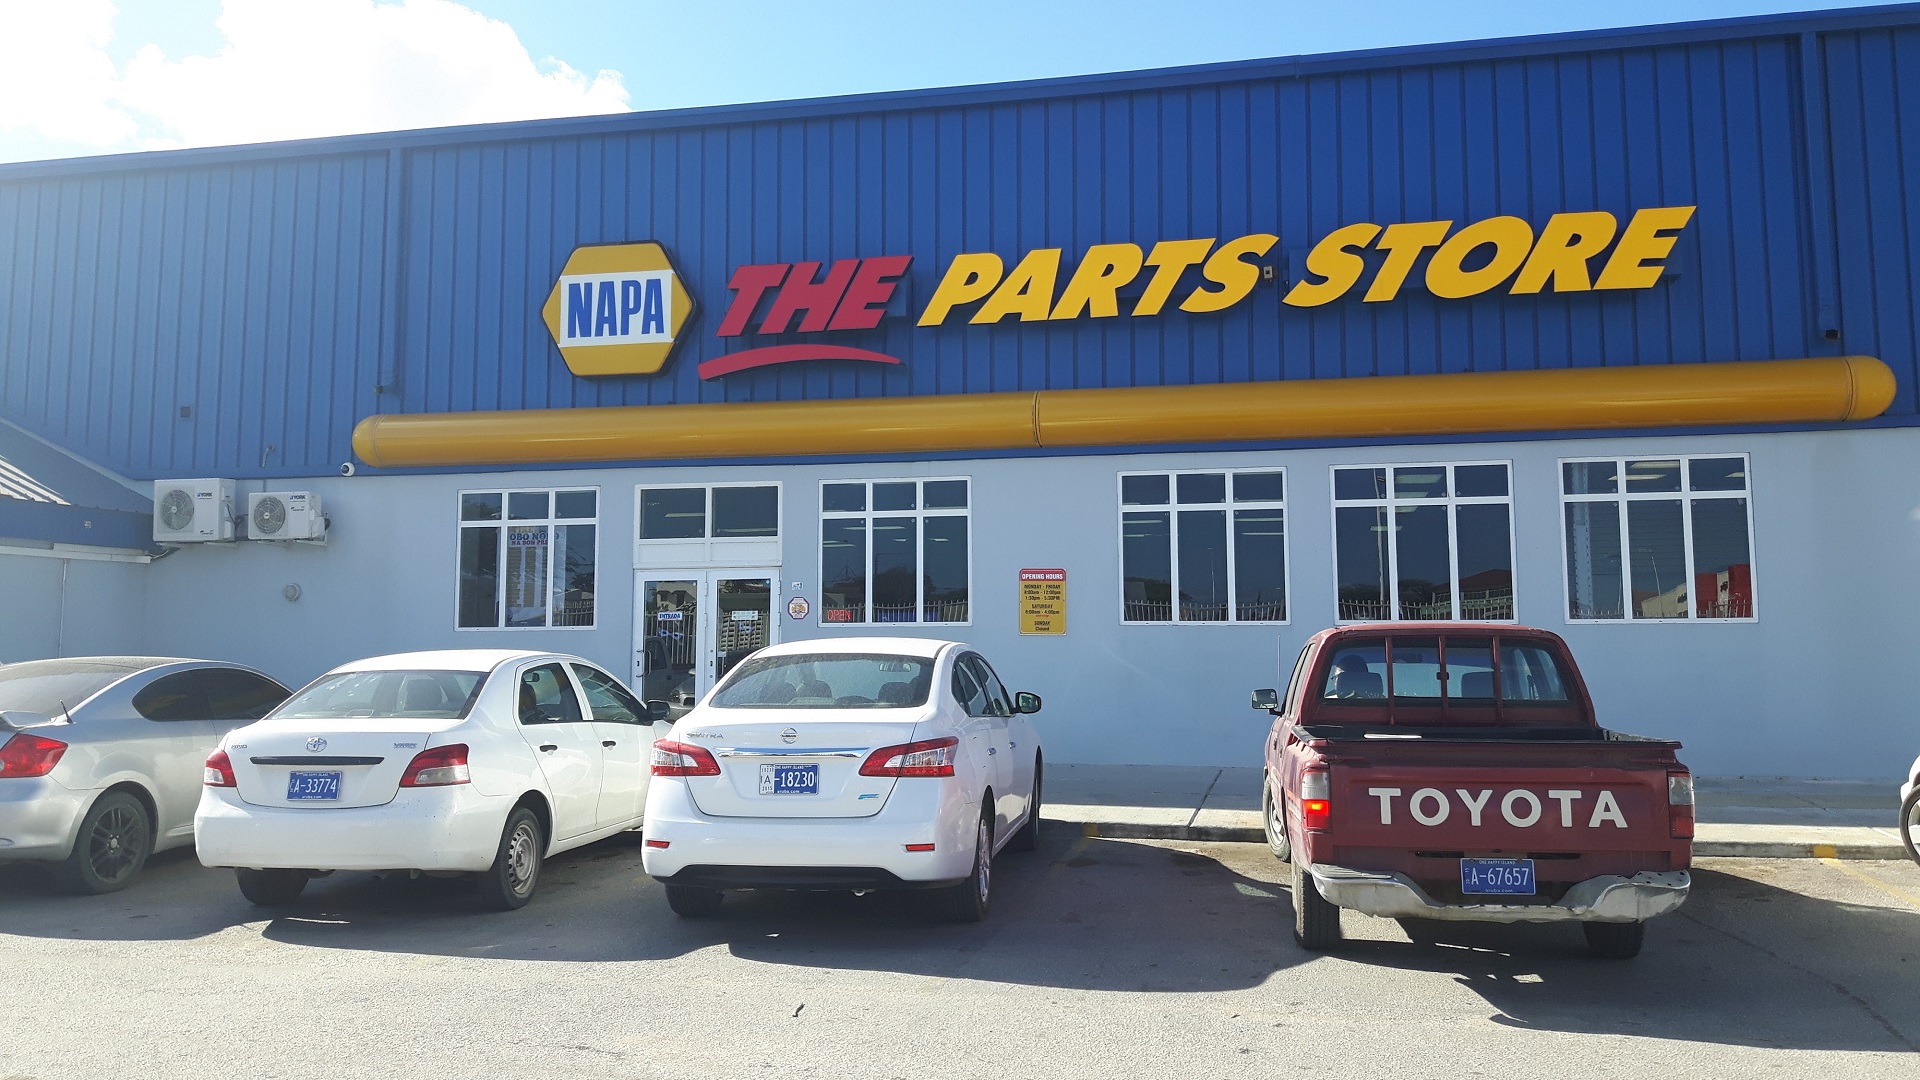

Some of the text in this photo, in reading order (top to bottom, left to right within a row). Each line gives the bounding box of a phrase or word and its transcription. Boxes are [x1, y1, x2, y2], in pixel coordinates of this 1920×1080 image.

[715, 205, 1697, 337] THE PARTS STORE
[567, 278, 664, 338] NAPA
[532, 532, 560, 540] NOO
[827, 609, 852, 620] OPEN
[293, 778, 337, 793] A-33774
[1368, 787, 1628, 828] TOYOTA
[1471, 866, 1529, 886] A-67657
